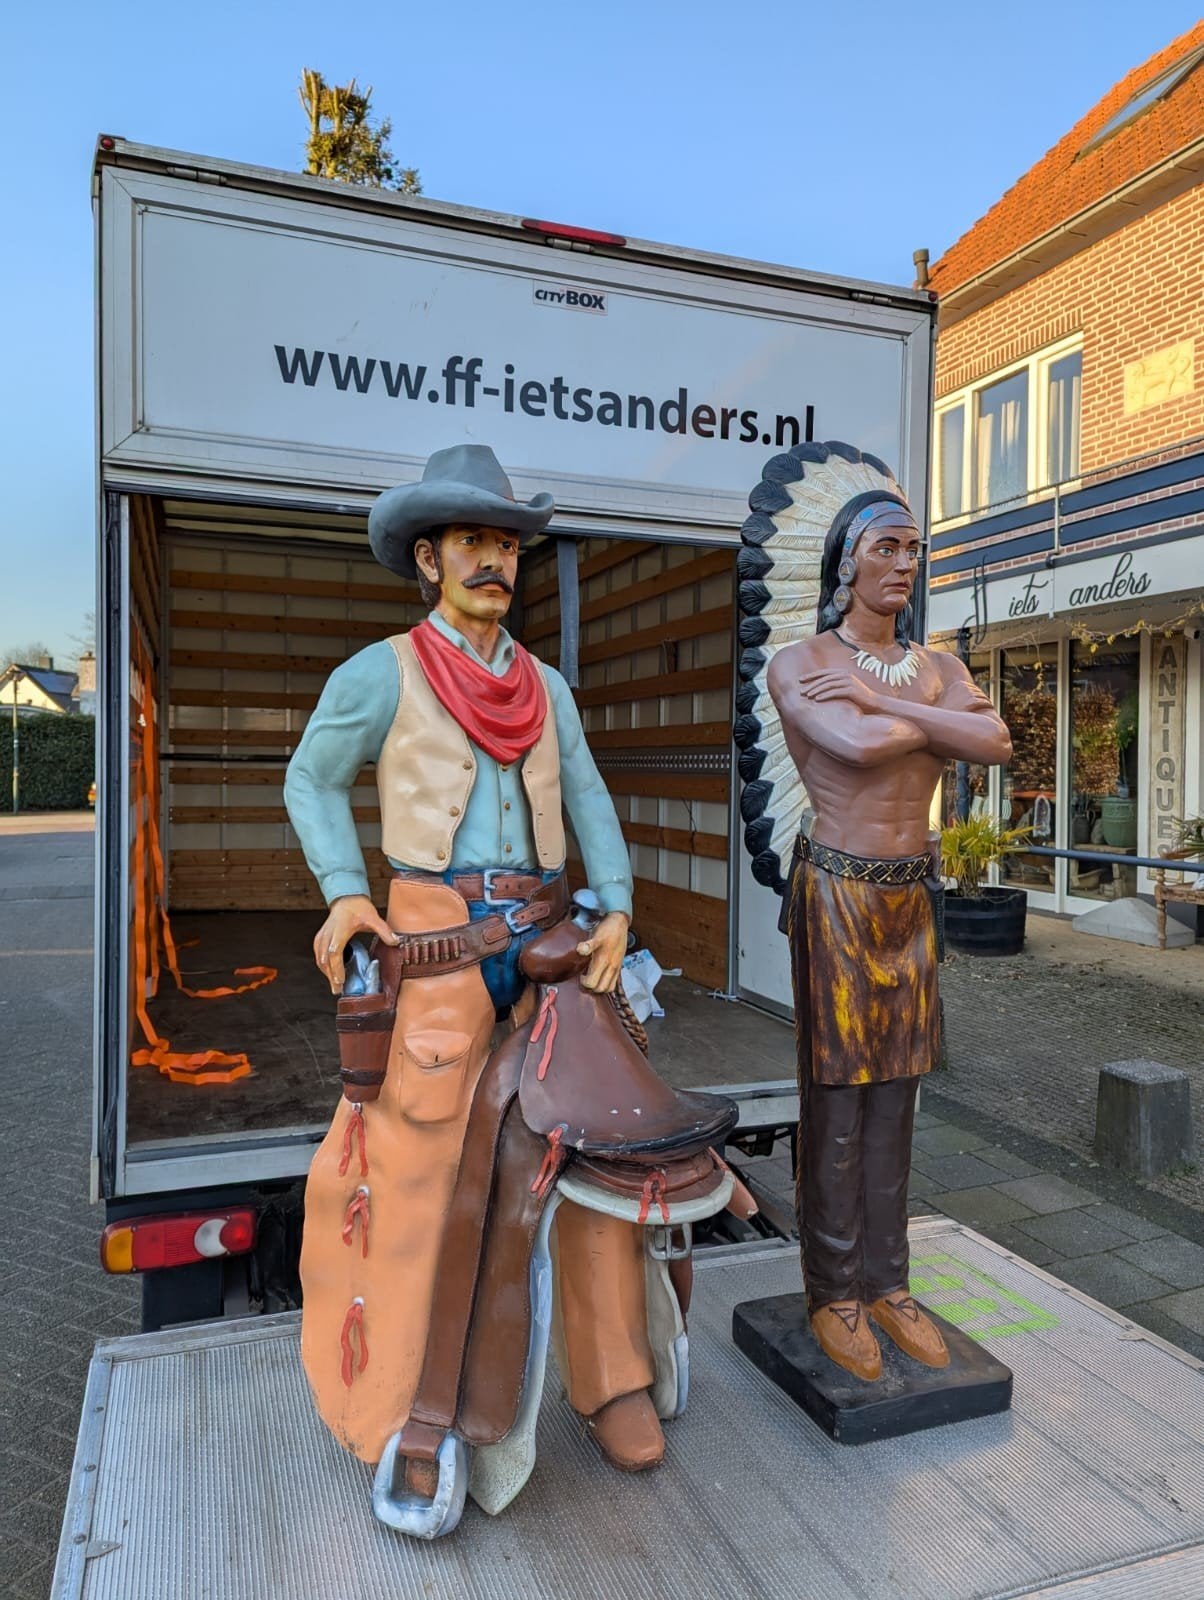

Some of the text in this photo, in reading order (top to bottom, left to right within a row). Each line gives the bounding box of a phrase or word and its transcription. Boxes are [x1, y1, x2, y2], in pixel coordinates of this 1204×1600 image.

[534, 289, 605, 310] CITYBOX
[274, 344, 815, 447] www.ff-ietsanders.nl
[1008, 573, 1049, 617] iets
[1069, 552, 1152, 607] anders
